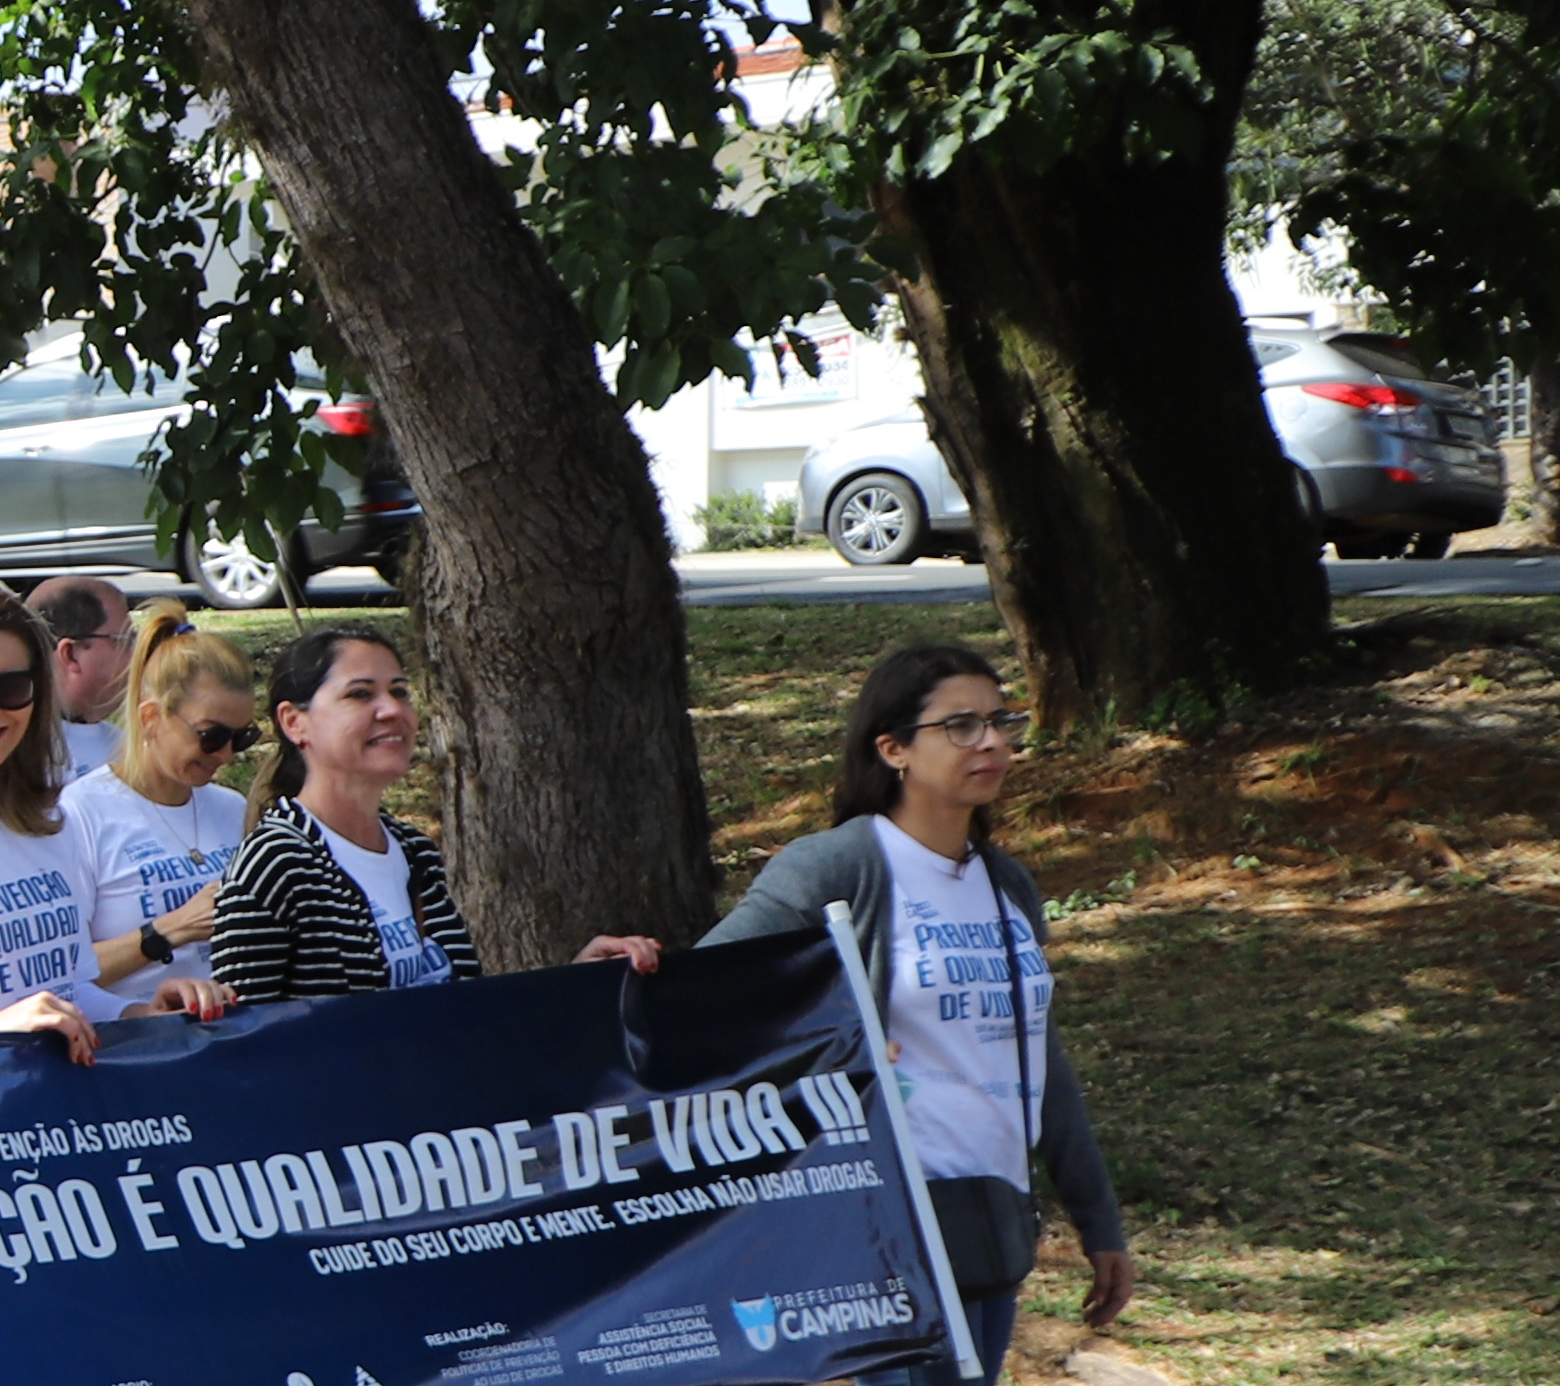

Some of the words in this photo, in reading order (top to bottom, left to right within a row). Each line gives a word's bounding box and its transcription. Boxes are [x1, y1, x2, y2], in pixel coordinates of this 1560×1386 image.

[140, 889, 157, 918] É
[17, 947, 67, 988] VIDA
[917, 955, 936, 988] É
[939, 991, 971, 1021] DE
[1034, 983, 1050, 1012] !!!
[72, 1118, 103, 1153] ÀS
[107, 1115, 193, 1149] DROGAS
[118, 1158, 179, 1251] É
[177, 1119, 543, 1250] QUALIDADE
[553, 1105, 639, 1190] DE
[649, 1082, 806, 1173] VIDA
[800, 1072, 871, 1146] !!!
[308, 1239, 377, 1276] CUIDE
[377, 1235, 409, 1267] DO
[411, 1230, 450, 1263] SEU
[450, 1223, 521, 1257] CORPO
[522, 1218, 542, 1243] E
[540, 1204, 615, 1240] MENTE.
[615, 1184, 716, 1226] ESCOLHA
[711, 1174, 757, 1210] NÃO
[756, 1167, 806, 1201] USAR
[808, 1159, 884, 1194] DROGAS.
[773, 1281, 879, 1310] PREFEITURA
[885, 1276, 907, 1293] DE
[598, 1323, 668, 1345] ASSISTÊNCIA
[780, 1293, 914, 1342] CAMPINAS
[424, 1321, 510, 1348] REALIZAÇÃO:
[458, 1338, 538, 1362] COORDENADORIA
[540, 1335, 557, 1349] DE
[577, 1346, 623, 1364] PESSOA
[623, 1342, 650, 1357] COM
[650, 1330, 717, 1354] DEFICIÊNCIA
[490, 1359, 504, 1373] DE
[505, 1349, 561, 1370] PREVENÇÃO
[490, 1373, 510, 1386] USO
[511, 1370, 524, 1383] DE
[526, 1364, 564, 1380] DROGAS
[606, 1362, 614, 1375] E
[614, 1353, 664, 1373] DIREITOS
[664, 1344, 720, 1366] HUMANOS
